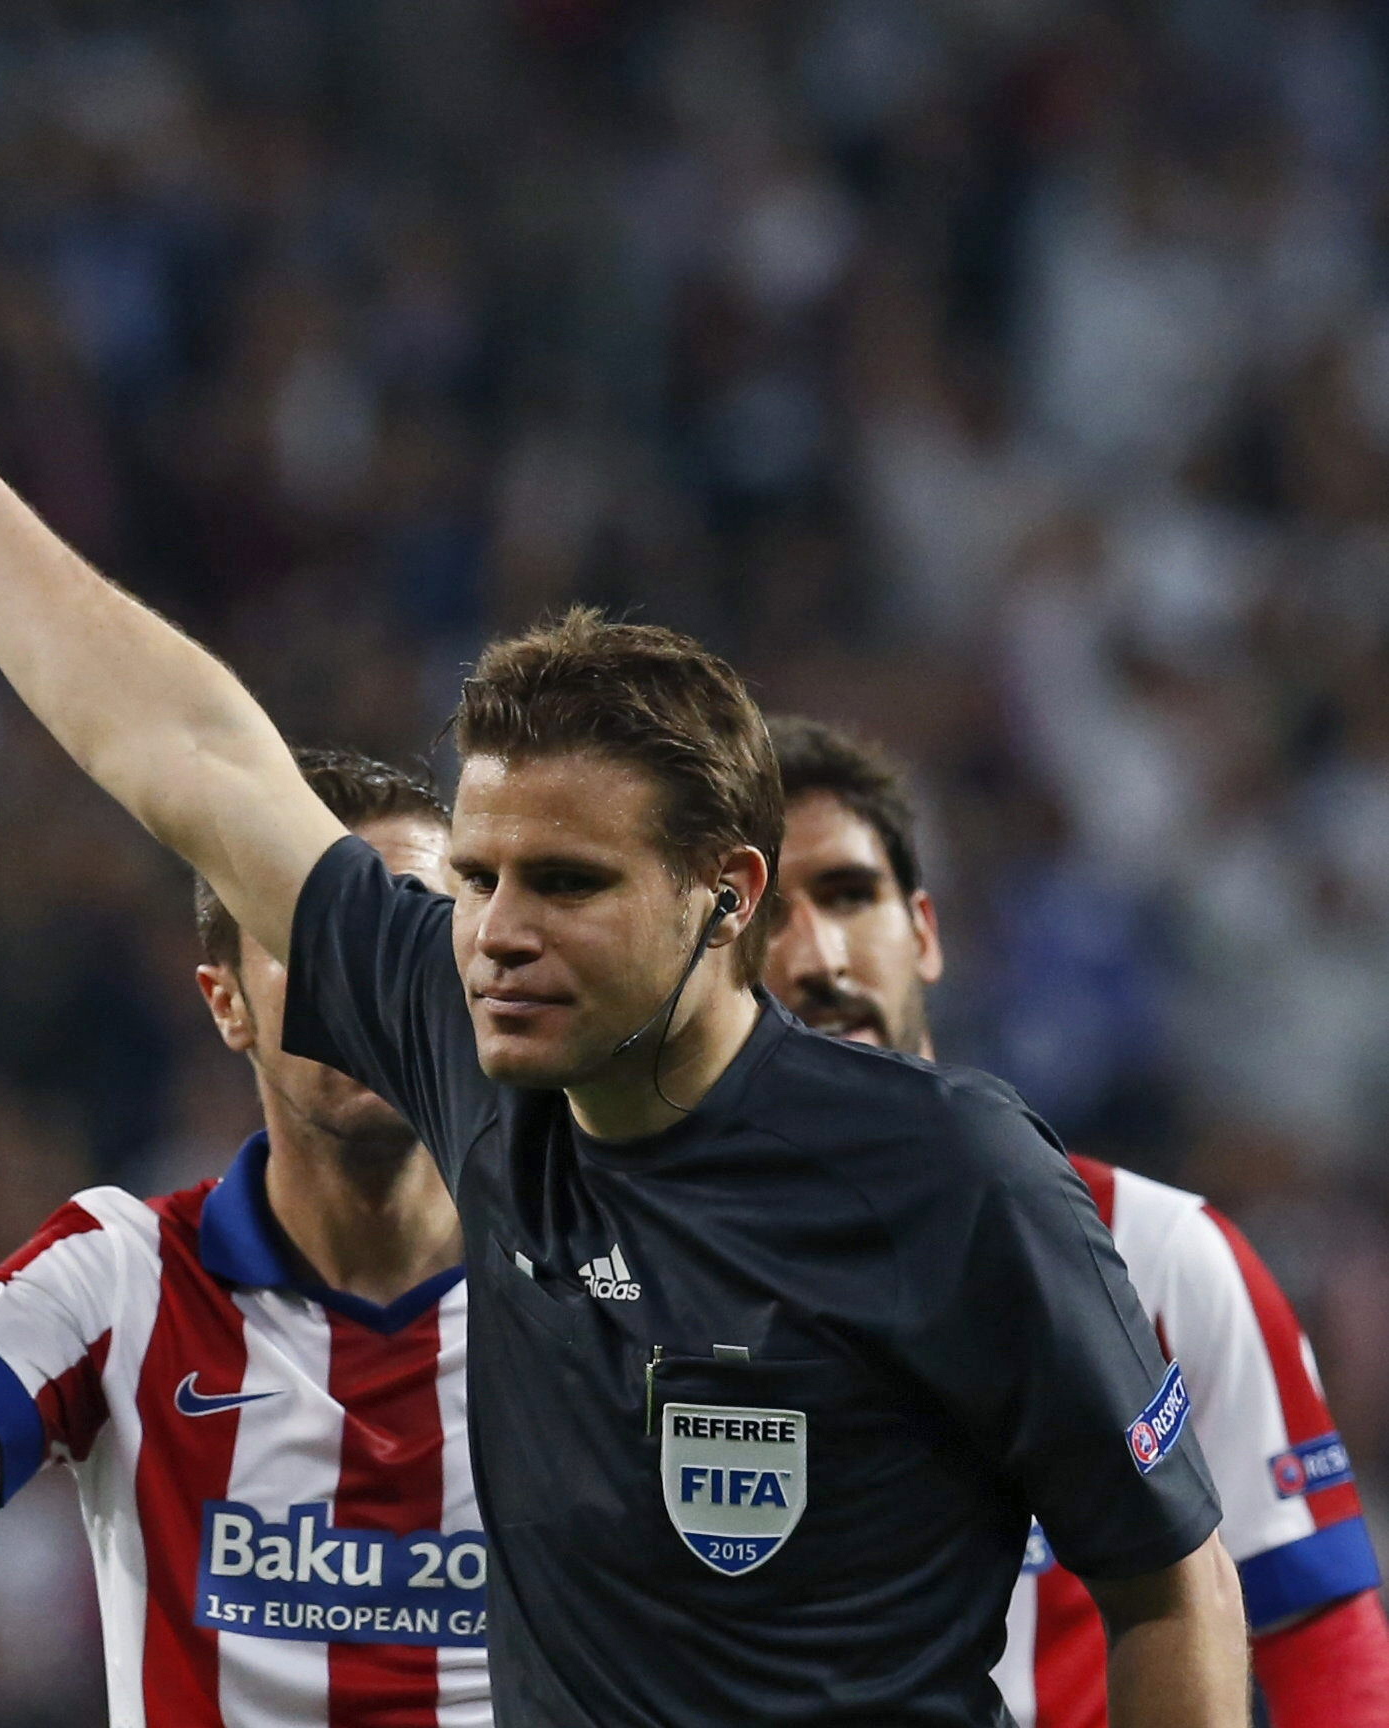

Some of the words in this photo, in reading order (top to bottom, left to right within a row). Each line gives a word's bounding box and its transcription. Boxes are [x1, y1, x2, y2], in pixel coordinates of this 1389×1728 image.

[673, 1415, 796, 1443] REFEREE
[681, 1466, 788, 1508] FIFA
[211, 1512, 383, 1587] Baku
[708, 1542, 757, 1561] 2015
[263, 1600, 439, 1634] EUROPEAN
